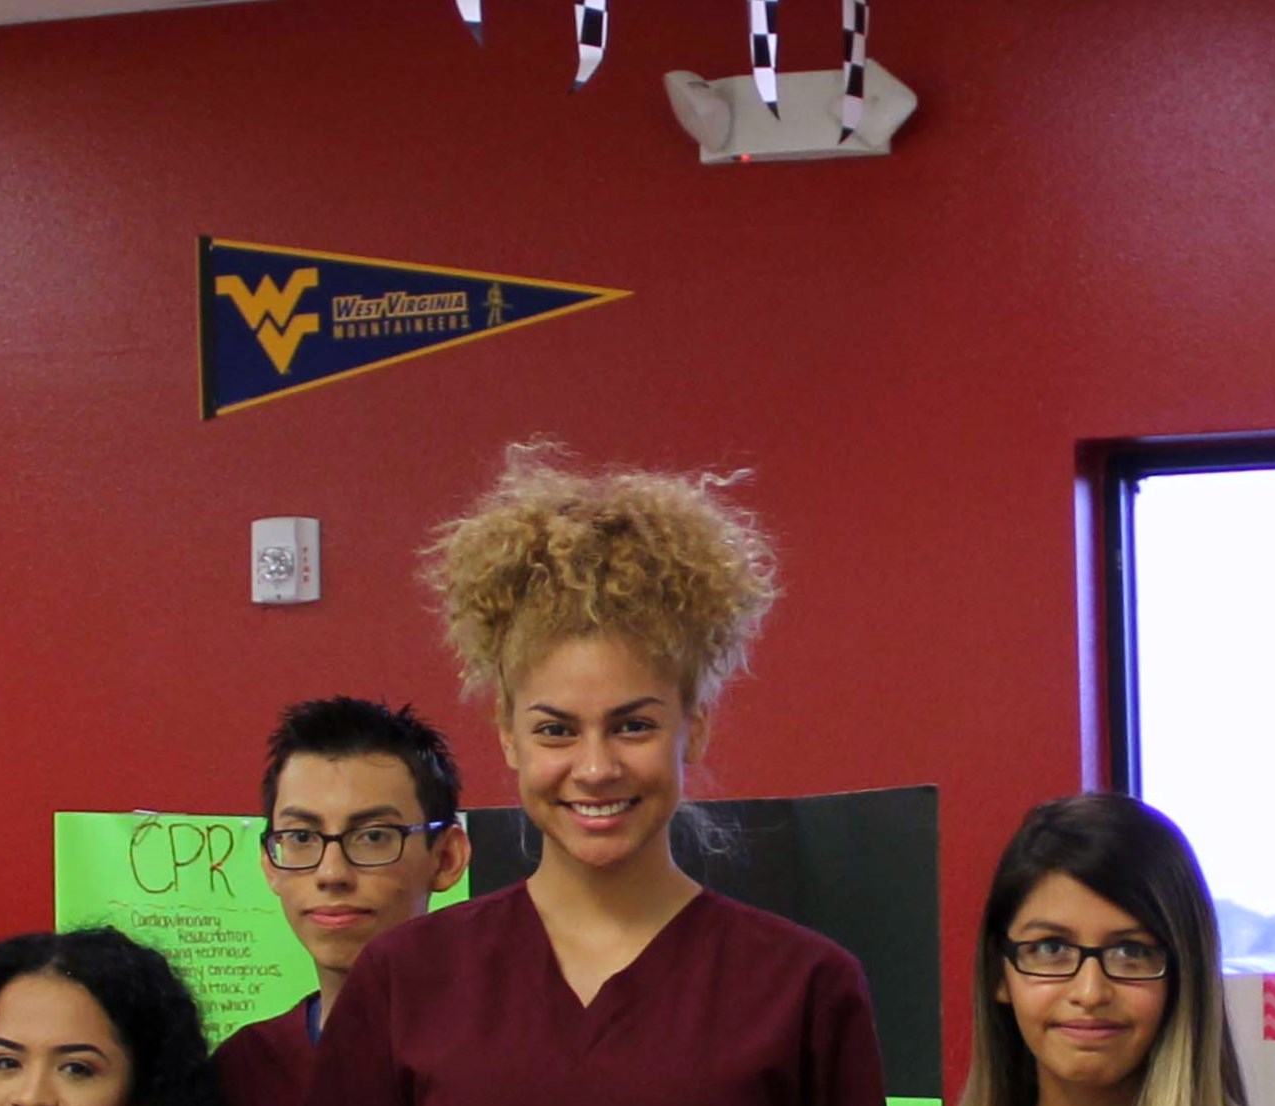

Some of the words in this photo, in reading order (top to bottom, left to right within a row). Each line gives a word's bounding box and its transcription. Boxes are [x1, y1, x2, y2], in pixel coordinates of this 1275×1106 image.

[334, 297, 382, 320] WEST
[386, 292, 466, 316] VIRGINIA
[333, 315, 470, 339] MOUNTAINEERS
[129, 822, 234, 897] CPR
